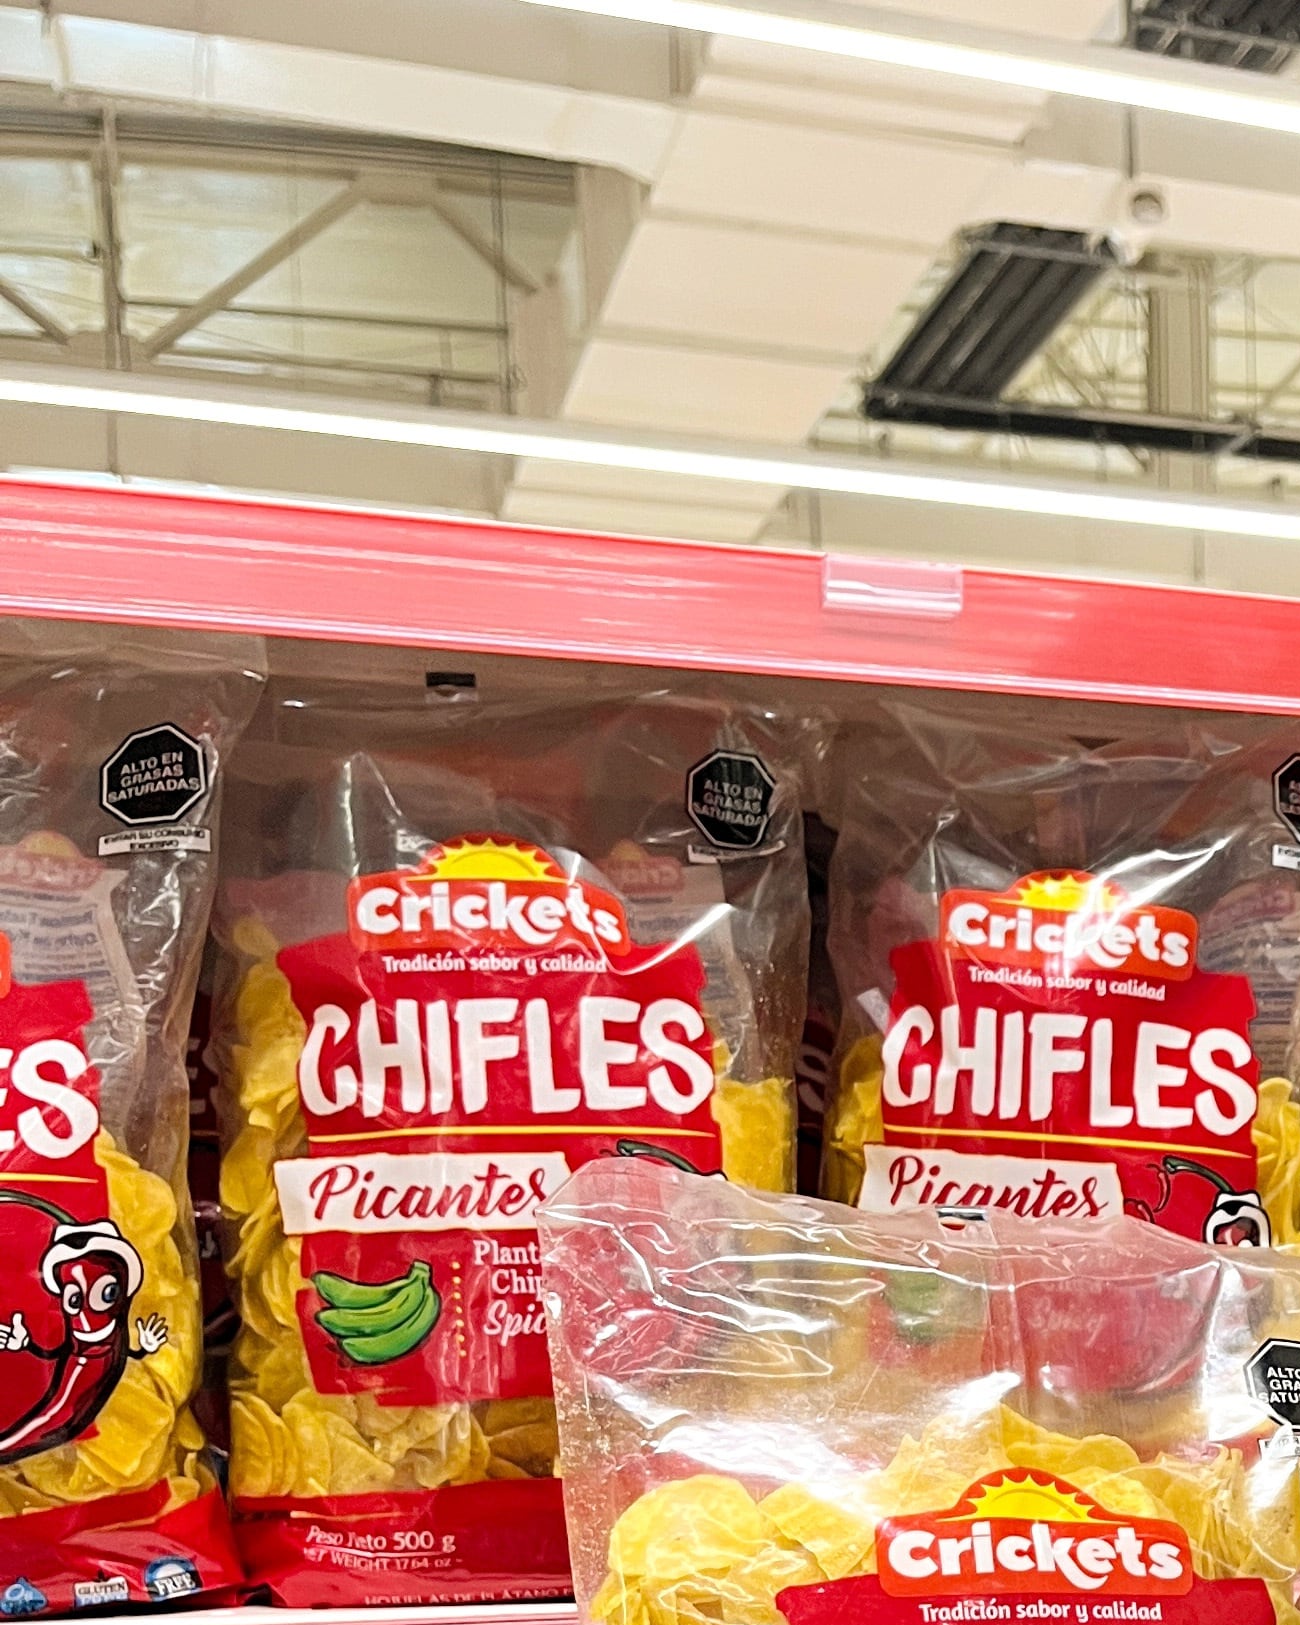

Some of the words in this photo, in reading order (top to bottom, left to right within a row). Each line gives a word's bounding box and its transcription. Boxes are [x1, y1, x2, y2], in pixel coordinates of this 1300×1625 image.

[120, 757, 157, 777] ALTO
[161, 751, 183, 765] EN
[120, 764, 184, 788] GRASAS
[107, 777, 200, 803] SATURADAS
[703, 779, 741, 796] ALTO
[744, 784, 763, 801] EN
[703, 791, 762, 814] GRASAS
[357, 882, 622, 944] Crickets
[948, 903, 1190, 968] Crickets
[382, 952, 465, 973] Tradición
[470, 954, 520, 972] sabor
[525, 958, 537, 975] y
[541, 954, 607, 973] calidad
[968, 965, 1043, 988] Tradición
[1046, 971, 1093, 990] sabor
[1096, 978, 1107, 996] y
[1110, 978, 1166, 1001] calidad
[300, 996, 715, 1119] CHIFLES
[881, 1004, 1258, 1138] CHIFLES
[309, 1161, 550, 1224] Picantes
[306, 1526, 342, 1547] Peso
[346, 1532, 386, 1551] Neto
[392, 1531, 434, 1551] 500
[441, 1534, 457, 1553] g
[331, 1552, 390, 1572] WEIGHT
[887, 1520, 1184, 1590] Crickets
[77, 1582, 126, 1596] GLUTEN
[155, 1572, 197, 1596] FREE
[918, 1603, 1011, 1623] Tradición
[1015, 1601, 1071, 1621] sabor
[1075, 1606, 1089, 1623] y
[1092, 1602, 1163, 1622] calidad
